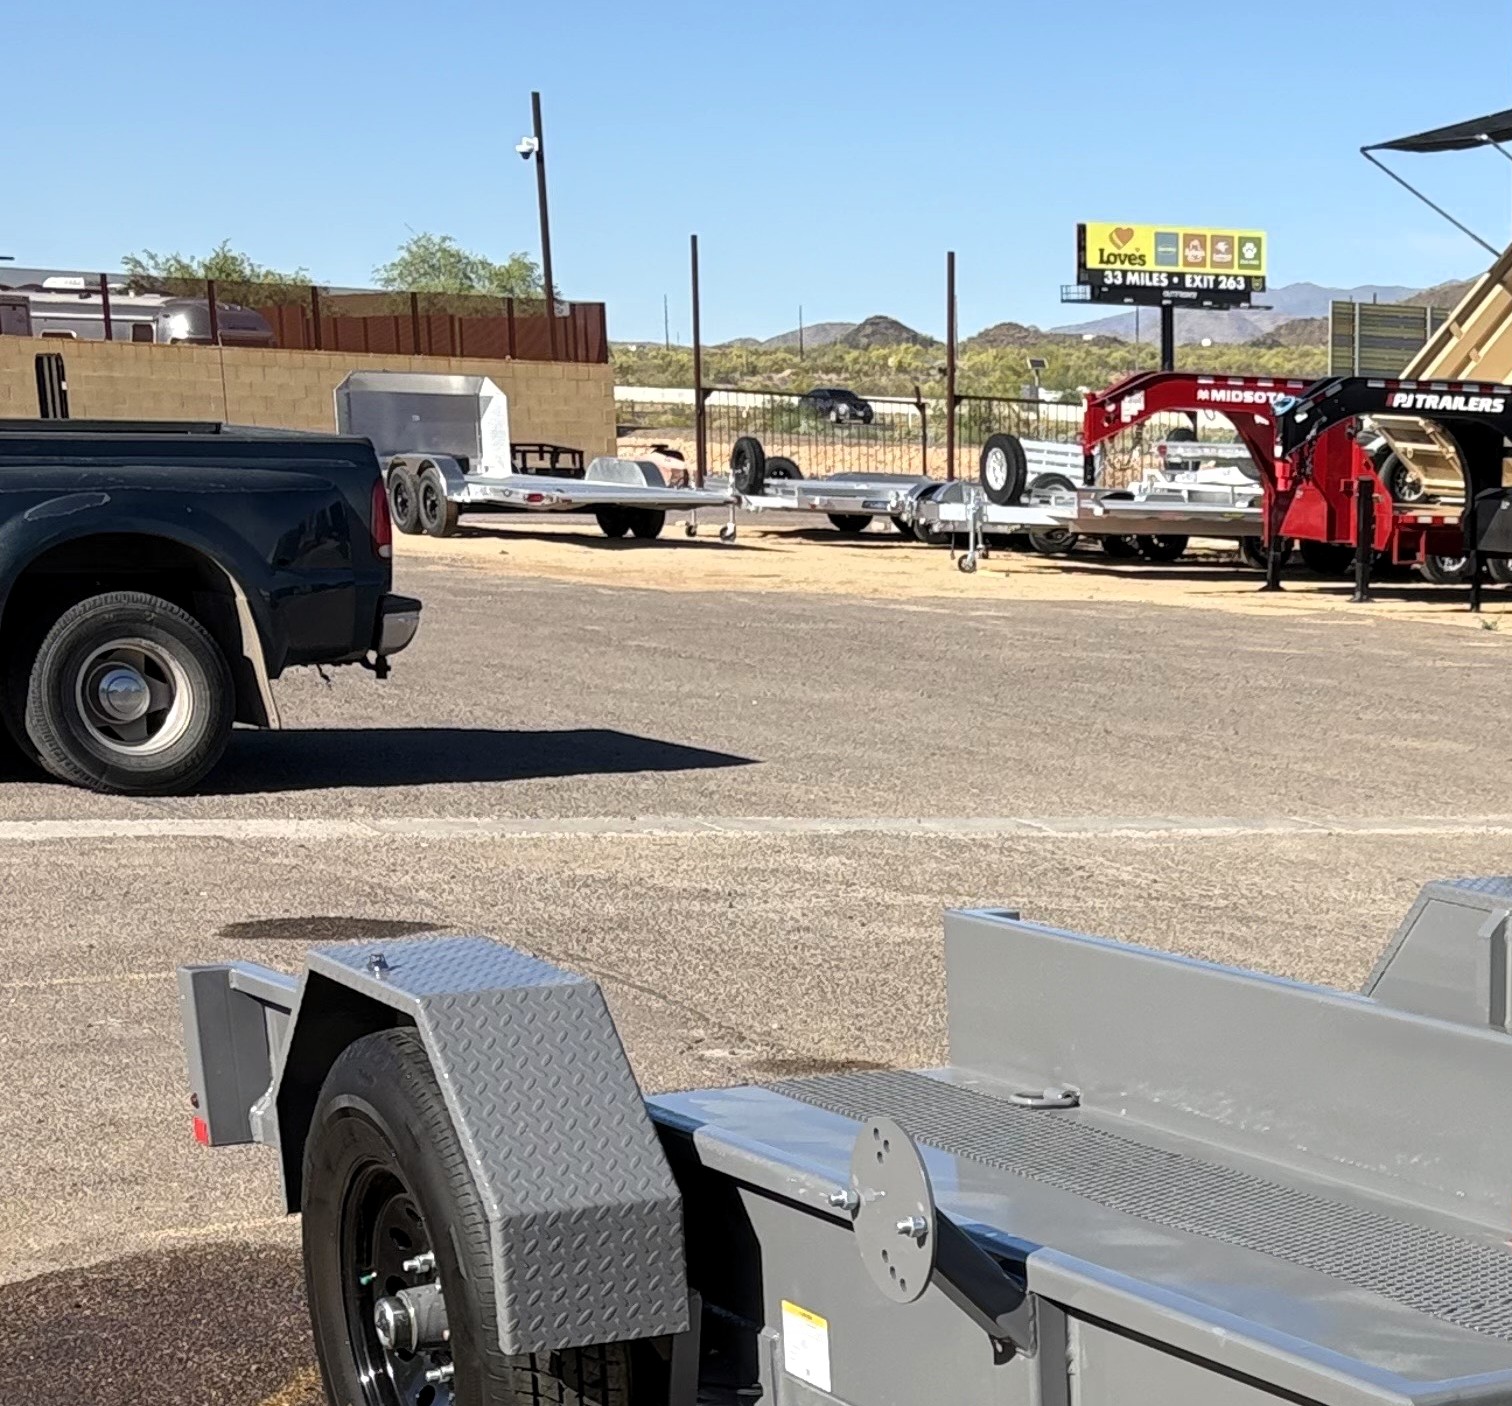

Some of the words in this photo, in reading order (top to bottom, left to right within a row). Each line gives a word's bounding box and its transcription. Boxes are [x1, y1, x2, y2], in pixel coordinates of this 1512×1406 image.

[1103, 270, 1122, 285] 33
[1125, 271, 1169, 288] MILES
[1185, 274, 1215, 289] EXIT
[1217, 275, 1246, 291] 263
[1393, 393, 1415, 408] PJ
[1414, 394, 1505, 413] TRAILERS
